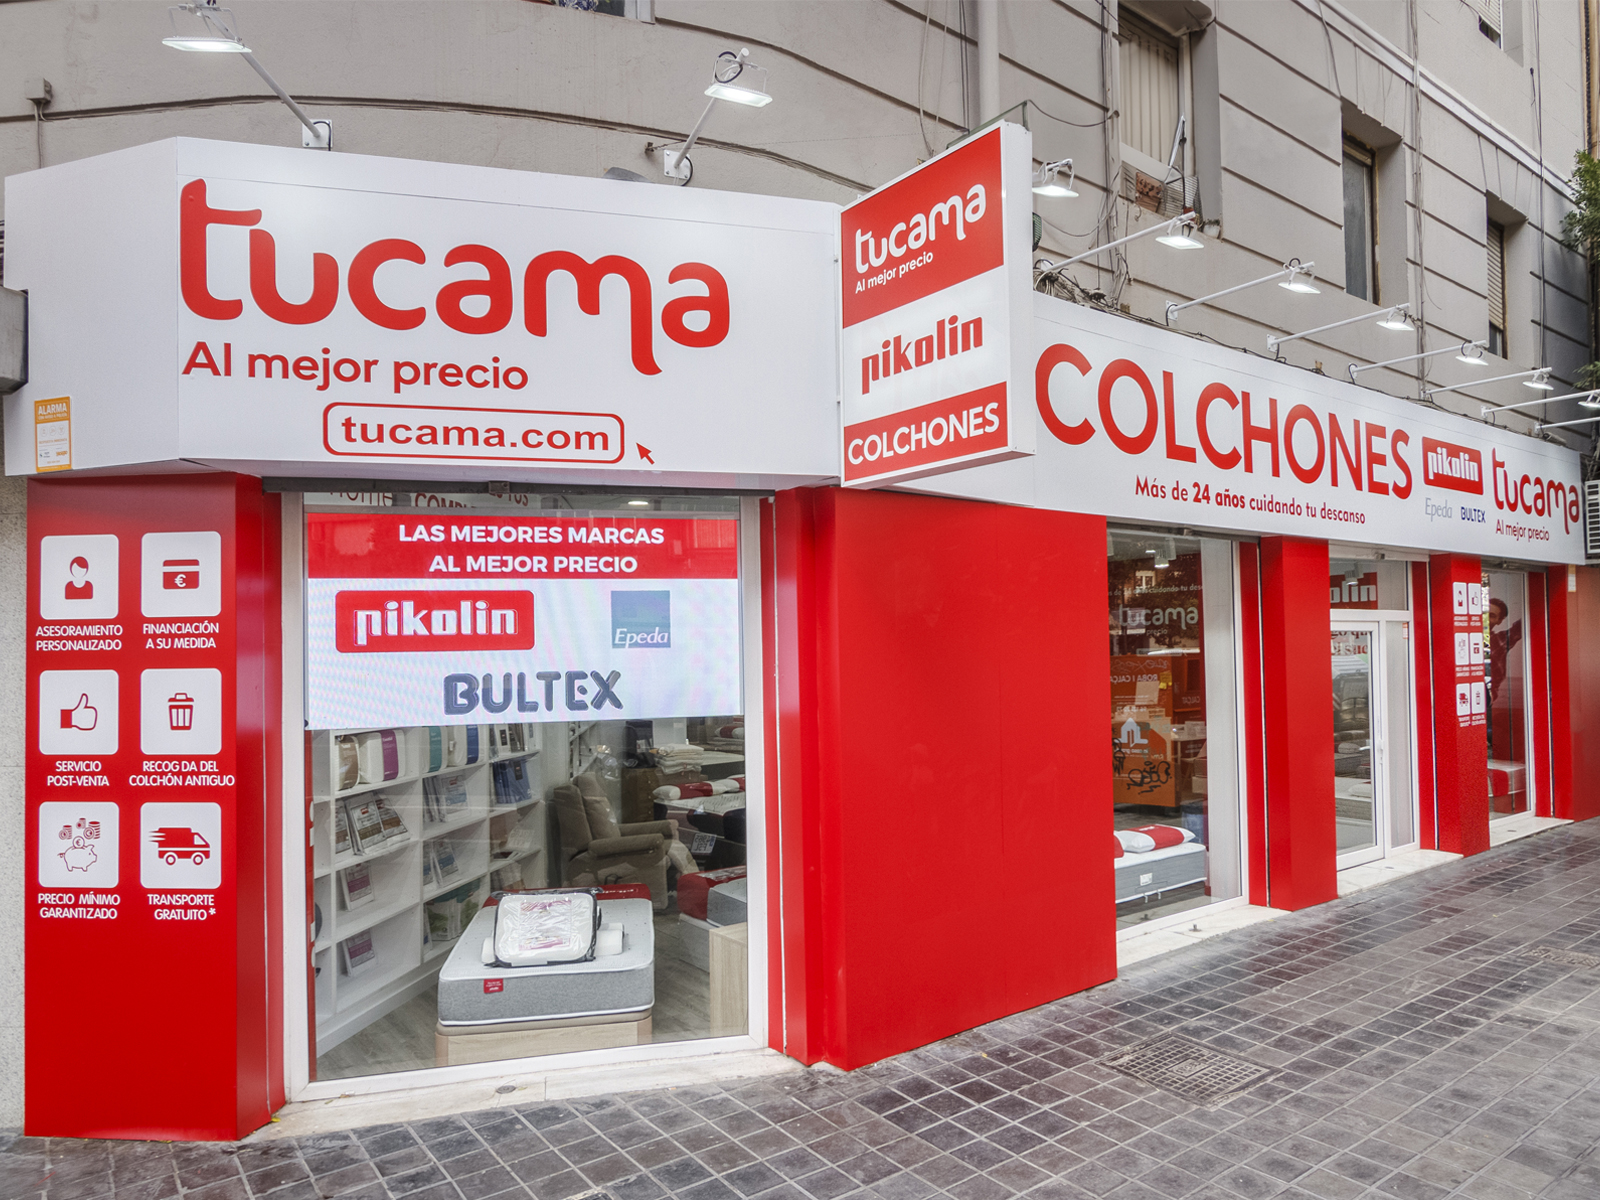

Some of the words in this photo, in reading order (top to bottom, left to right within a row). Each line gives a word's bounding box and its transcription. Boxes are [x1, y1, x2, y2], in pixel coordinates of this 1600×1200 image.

[854, 183, 988, 275] tucama
[180, 177, 731, 377] tucama
[855, 279, 866, 295] Al
[867, 268, 897, 286] mejor
[899, 251, 934, 279] precio
[861, 314, 983, 396] pikolin
[181, 340, 233, 377] Al
[247, 346, 379, 392] mejor
[393, 356, 529, 394] precio
[38, 403, 67, 415] ALARMA
[1035, 342, 1413, 501] COLCHONES
[340, 416, 610, 452] tucama.com
[847, 402, 1000, 466] COLCHONES
[1427, 447, 1479, 481] pikolin
[1135, 474, 1167, 499] Más
[1171, 480, 1189, 502] de
[1192, 481, 1211, 504] 24
[1214, 488, 1246, 509] años
[1249, 494, 1302, 517] cuidando
[1305, 502, 1317, 518] tu
[1320, 502, 1366, 525] descanso
[1492, 447, 1580, 536] tucama
[1425, 497, 1453, 523] Epeda
[1460, 506, 1486, 524] BULTEX
[399, 524, 445, 543] LAS
[450, 525, 563, 544] MEJORES
[567, 527, 665, 545] MARCAS
[1495, 519, 1505, 536] Al
[1505, 523, 1526, 542] mejor
[1528, 526, 1550, 543] precio
[428, 555, 461, 573] AL
[465, 555, 549, 573] MEJOR
[553, 556, 639, 573] PRECIO
[142, 620, 219, 635] FINANCIACIÓN
[353, 600, 519, 647] pikolin
[1119, 604, 1199, 630] tucama
[35, 624, 123, 637] ASESORAMIENTO
[614, 627, 669, 648] Epeda
[35, 639, 122, 651] PERSONALIZADO
[145, 638, 155, 649] A
[156, 638, 172, 649] SU
[173, 637, 217, 649] MEDIDA
[443, 669, 624, 716] BULTEX
[55, 761, 102, 772] SERVICIO
[200, 761, 219, 772] DEL
[47, 775, 110, 787] POST-VENTA
[128, 773, 183, 786] COLCHÓN
[184, 775, 235, 786] ANTIGUO
[37, 893, 75, 905] PRECIO
[78, 891, 121, 906] MÍNIMO
[147, 894, 215, 906] TRANSPORTE
[39, 907, 118, 920] GARANTIZADO
